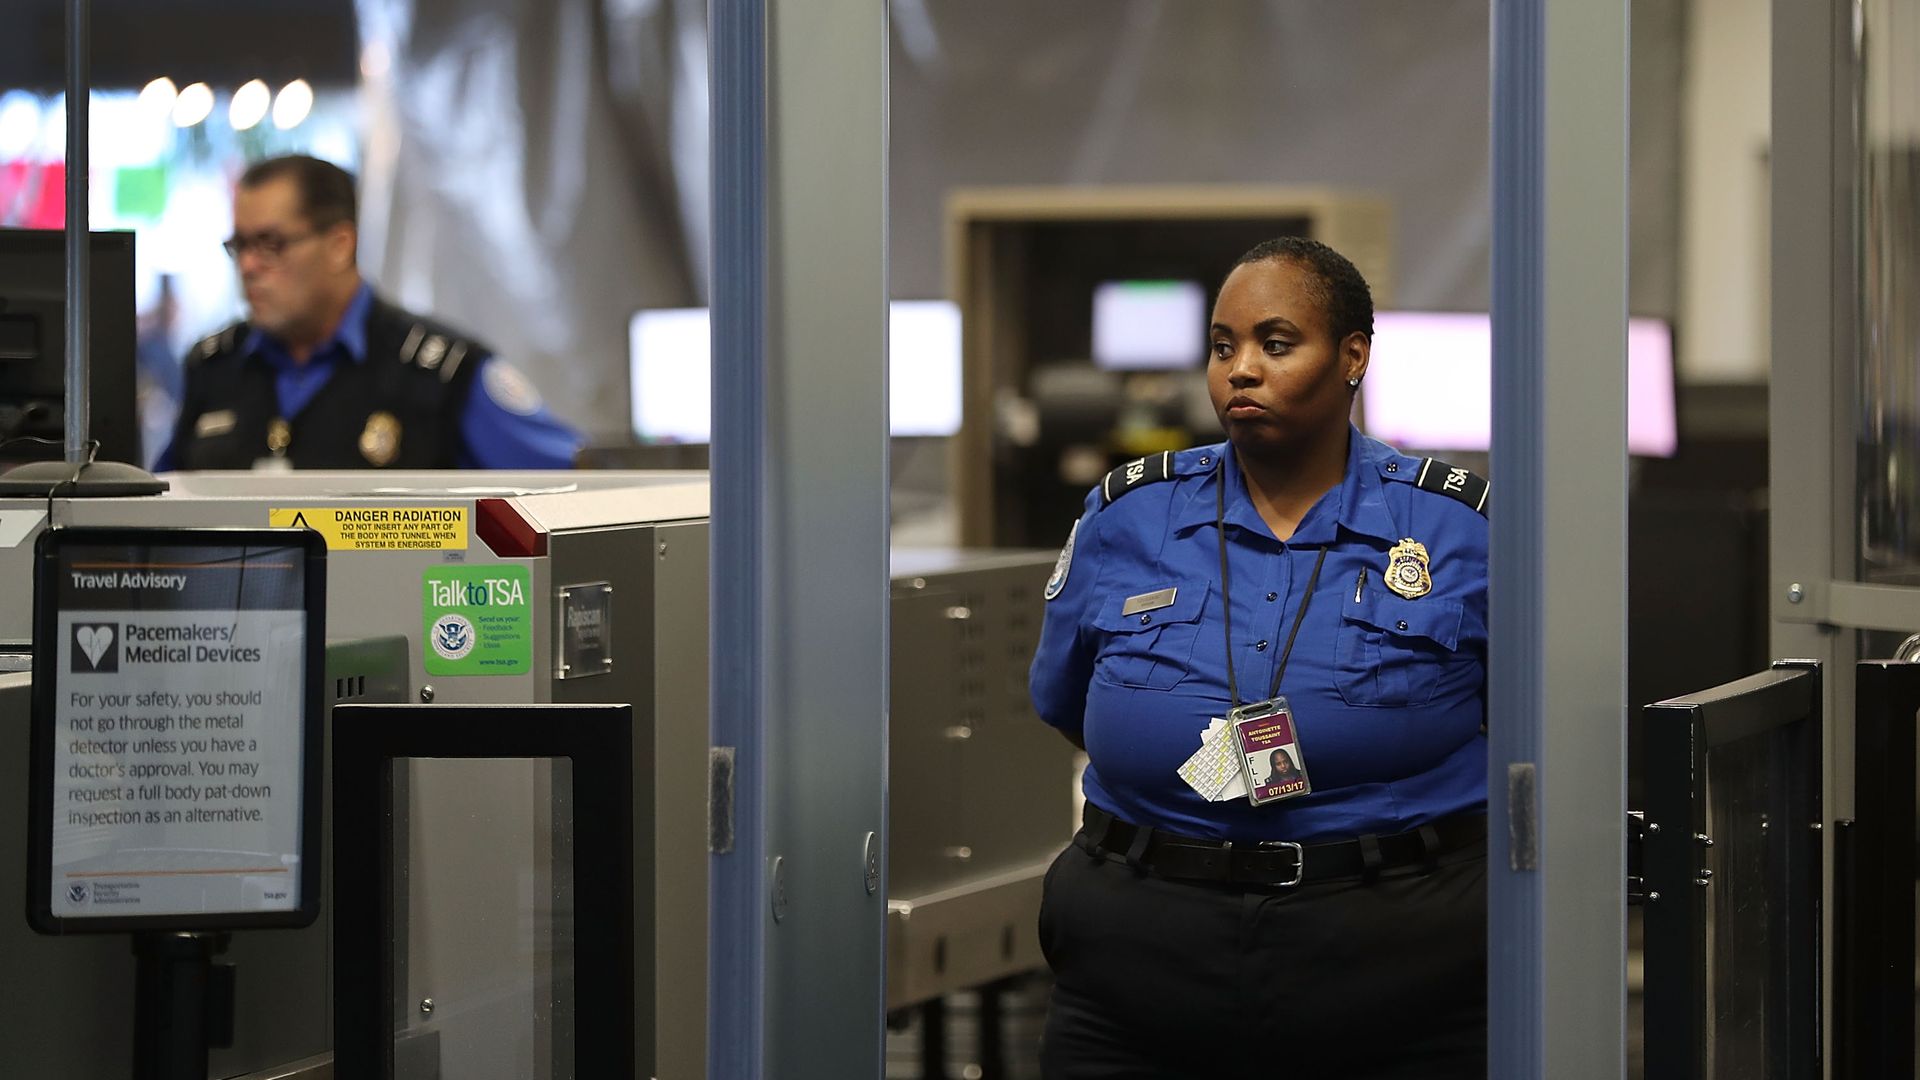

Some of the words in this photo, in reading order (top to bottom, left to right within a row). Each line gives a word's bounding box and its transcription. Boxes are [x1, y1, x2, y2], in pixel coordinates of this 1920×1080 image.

[1126, 457, 1145, 485] TSA
[1443, 468, 1469, 491] TSA
[335, 511, 388, 521] DANGER
[393, 511, 461, 521] RADIATION
[71, 572, 117, 589] Travel
[121, 572, 186, 591] Advisory
[125, 624, 237, 641] Pacemakers/
[125, 646, 191, 663] Medical
[196, 646, 261, 662] Devices
[71, 693, 94, 707] For
[100, 694, 131, 709] your
[136, 692, 181, 709] safety,
[185, 693, 212, 708] you
[216, 691, 261, 705] should
[70, 716, 93, 731] not
[97, 719, 115, 732] go
[119, 715, 174, 732] through
[179, 715, 201, 729] the
[205, 714, 243, 729] metal
[69, 739, 129, 754] detector
[133, 738, 177, 753] unless
[180, 741, 207, 755] you
[211, 738, 245, 752] have
[249, 741, 257, 751] a
[69, 763, 125, 778] doctor's
[129, 761, 194, 779] approval.
[199, 761, 224, 776] You
[228, 763, 259, 778] may
[68, 786, 122, 803] request
[126, 788, 134, 800] a
[139, 785, 160, 800] full
[165, 785, 200, 801] body
[205, 785, 271, 801] pat-down
[1269, 781, 1303, 796] 07/13/17
[68, 809, 141, 827] inspection
[145, 811, 160, 823] as
[165, 811, 181, 822] an
[185, 806, 263, 823] alternative.
